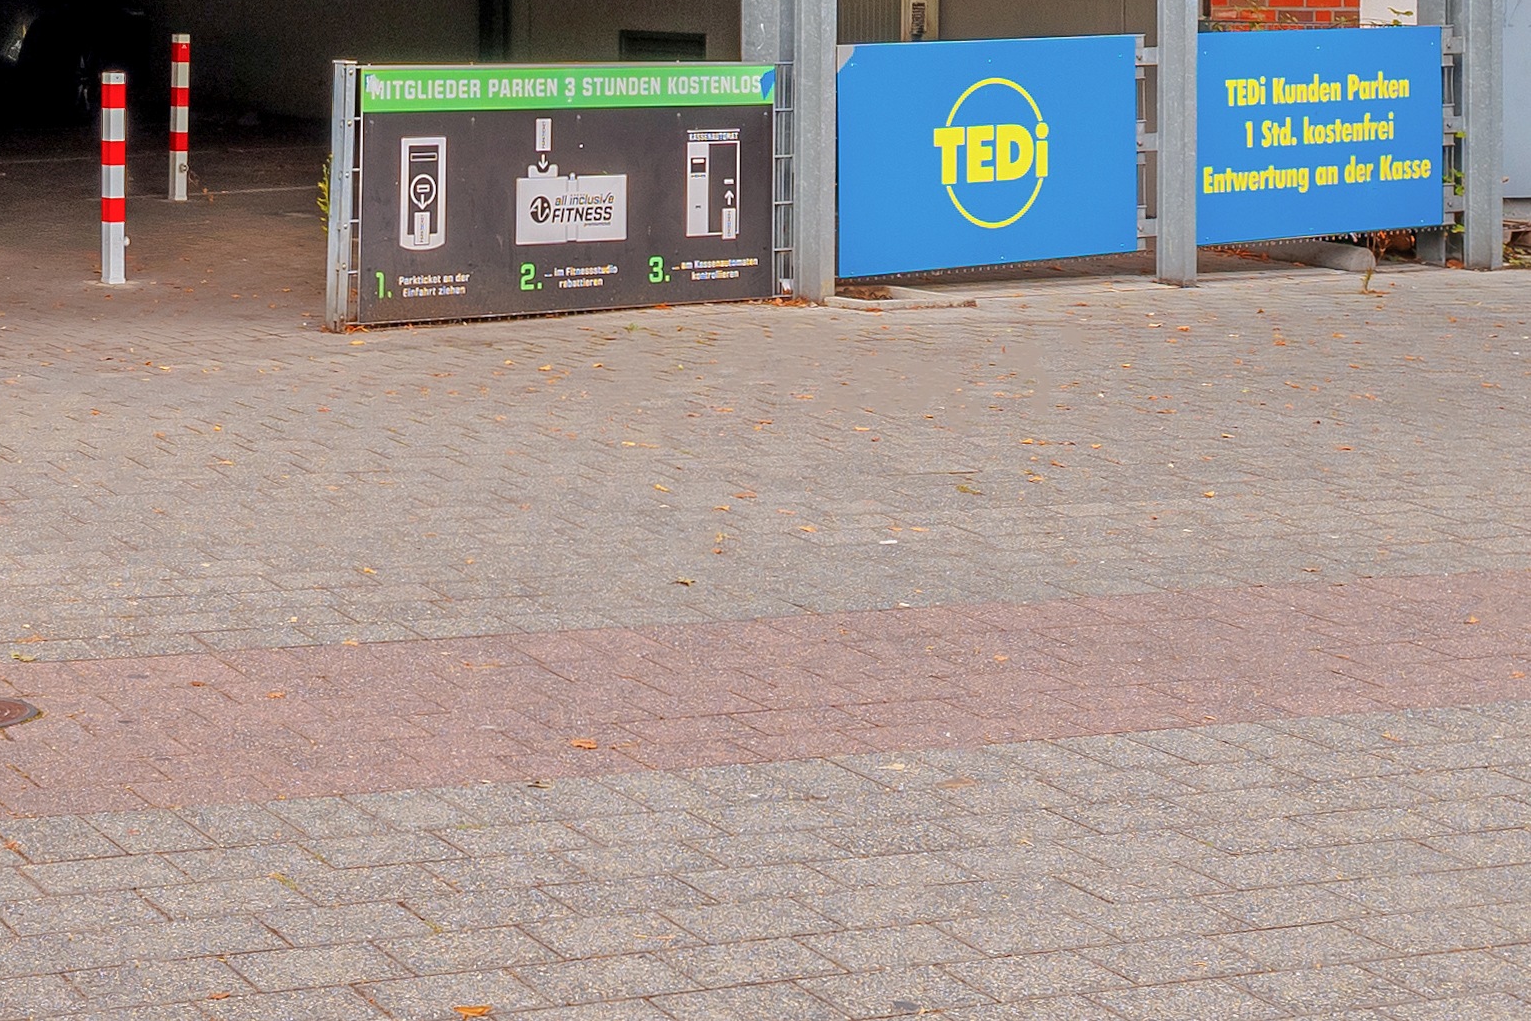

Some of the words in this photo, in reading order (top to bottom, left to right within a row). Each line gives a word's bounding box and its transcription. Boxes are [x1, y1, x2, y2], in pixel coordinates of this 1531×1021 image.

[370, 78, 481, 100] MITGLIEDER
[488, 78, 558, 99] PARKEN
[564, 77, 576, 97] 3
[582, 76, 661, 97] STUNDEN
[667, 75, 761, 96] KOSTENLOS
[1225, 75, 1266, 107] TEDi
[1272, 73, 1342, 105] Kunden
[1347, 71, 1410, 101] Parken
[1244, 120, 1254, 148] 1
[1261, 116, 1297, 148] Std.
[1303, 111, 1395, 145] kostenfrei
[933, 122, 1049, 186] TEDi
[1203, 164, 1310, 194] Entwertung
[1315, 165, 1339, 186] an
[1344, 155, 1374, 184] der
[1379, 154, 1432, 181] Kasse
[552, 206, 613, 223] FITNESS
[555, 195, 567, 206] all
[520, 263, 543, 291] 2.
[649, 256, 671, 283] 3.
[375, 271, 393, 299] 1.
